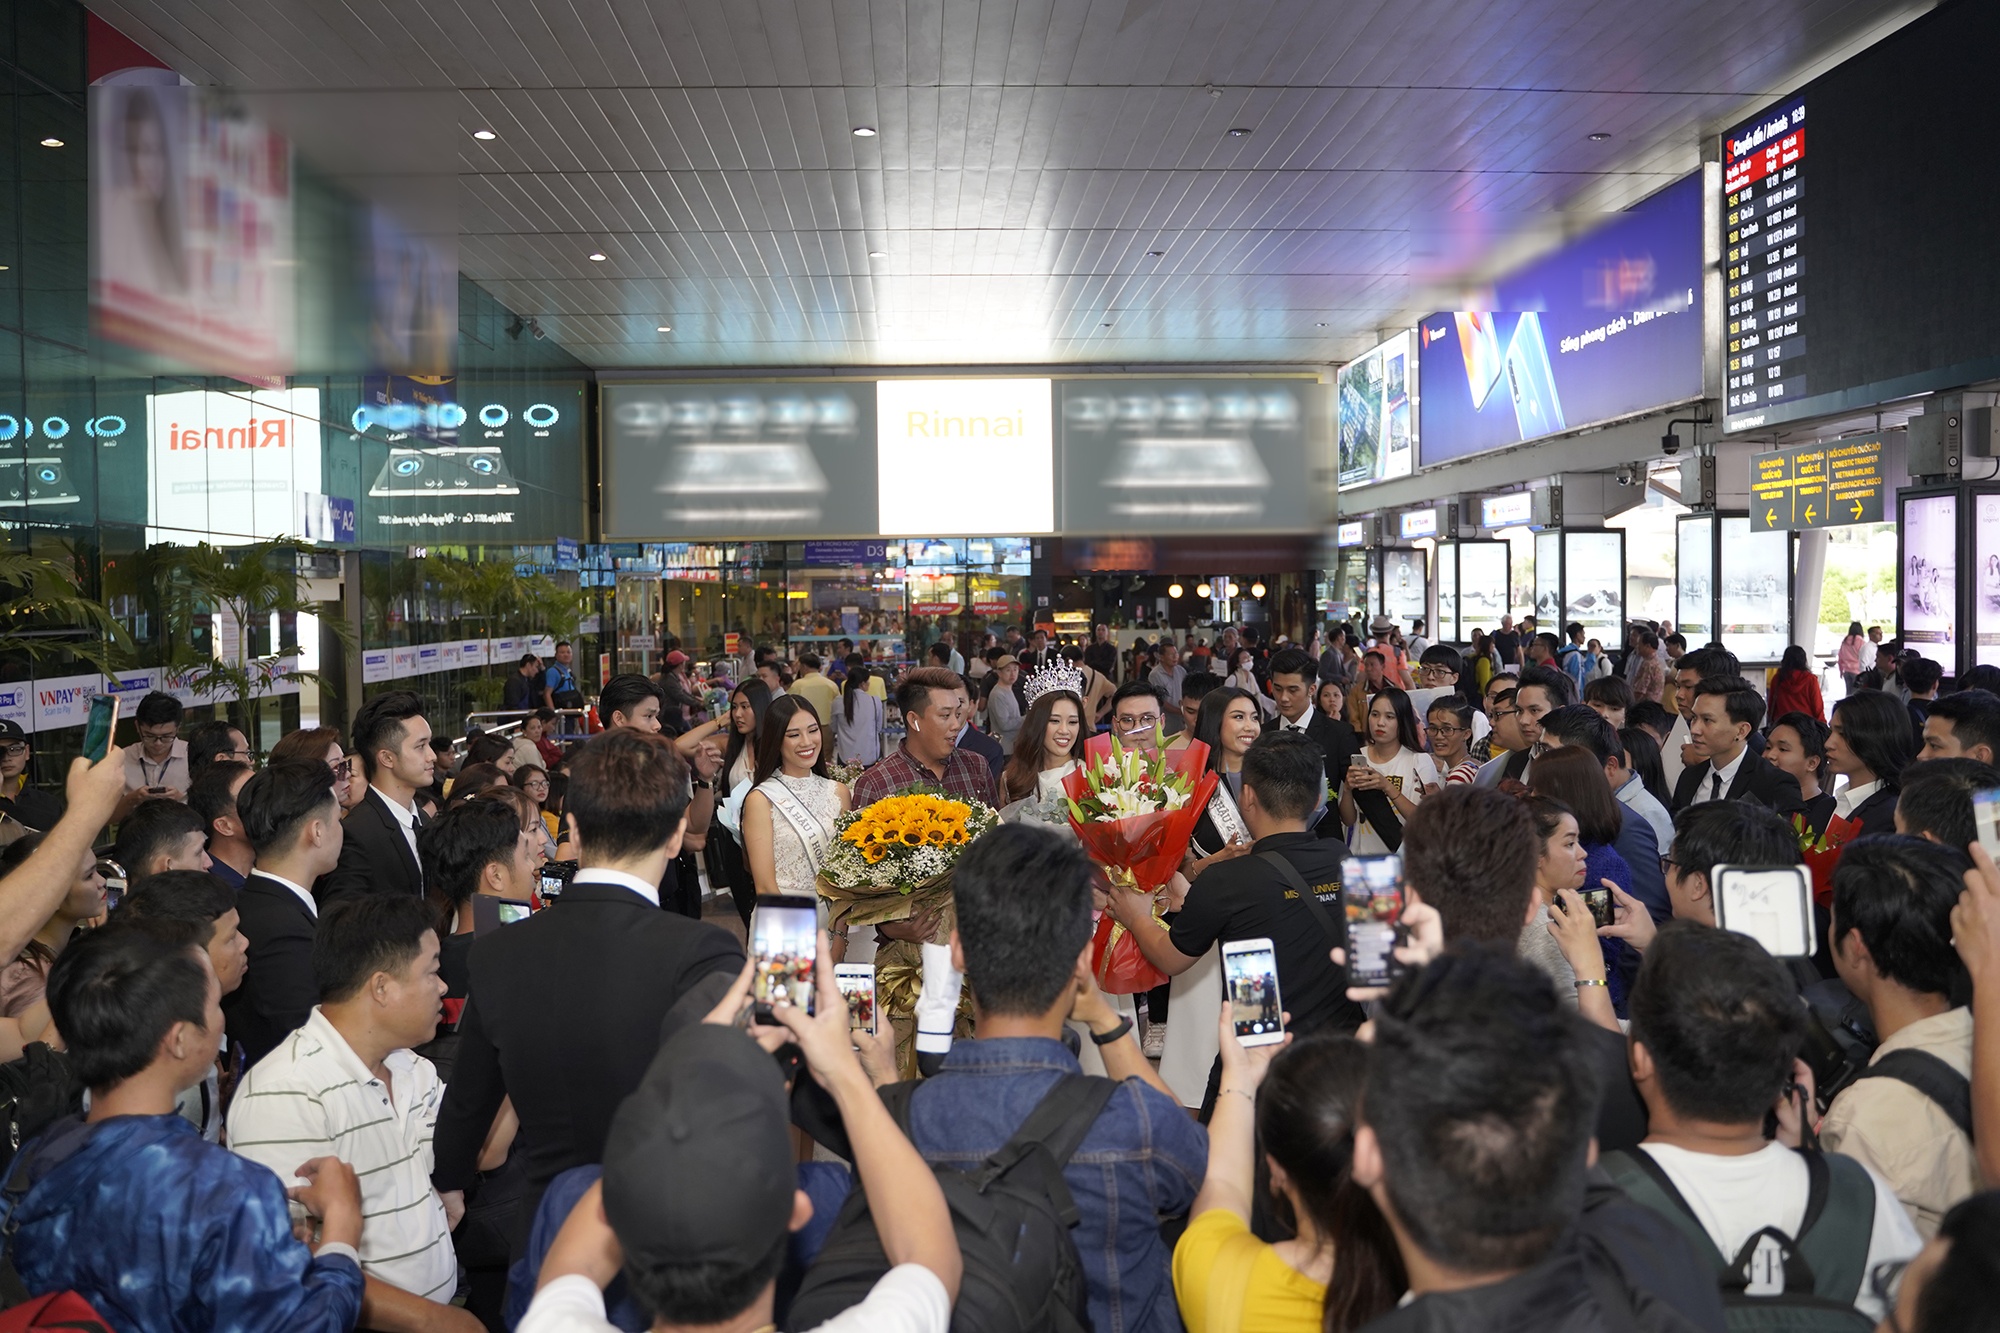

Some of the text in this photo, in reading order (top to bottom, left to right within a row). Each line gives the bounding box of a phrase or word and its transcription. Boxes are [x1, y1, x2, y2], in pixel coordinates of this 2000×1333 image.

[1734, 132, 1752, 156] Chuyến
[1767, 115, 1787, 139] Arrivals
[1580, 326, 1606, 349] phong
[907, 409, 1023, 437] Rinnai
[1832, 455, 1878, 469] DOMESTIC TRANSFER
[1794, 475, 1827, 486] INTERNATIONAL
[1799, 486, 1822, 496] TRANSFER
[342, 510, 354, 531] A2
[867, 545, 884, 557] D3
[44, 707, 55, 716] Scan
[62, 706, 71, 715] Pay
[1284, 889, 1300, 899] MIS
